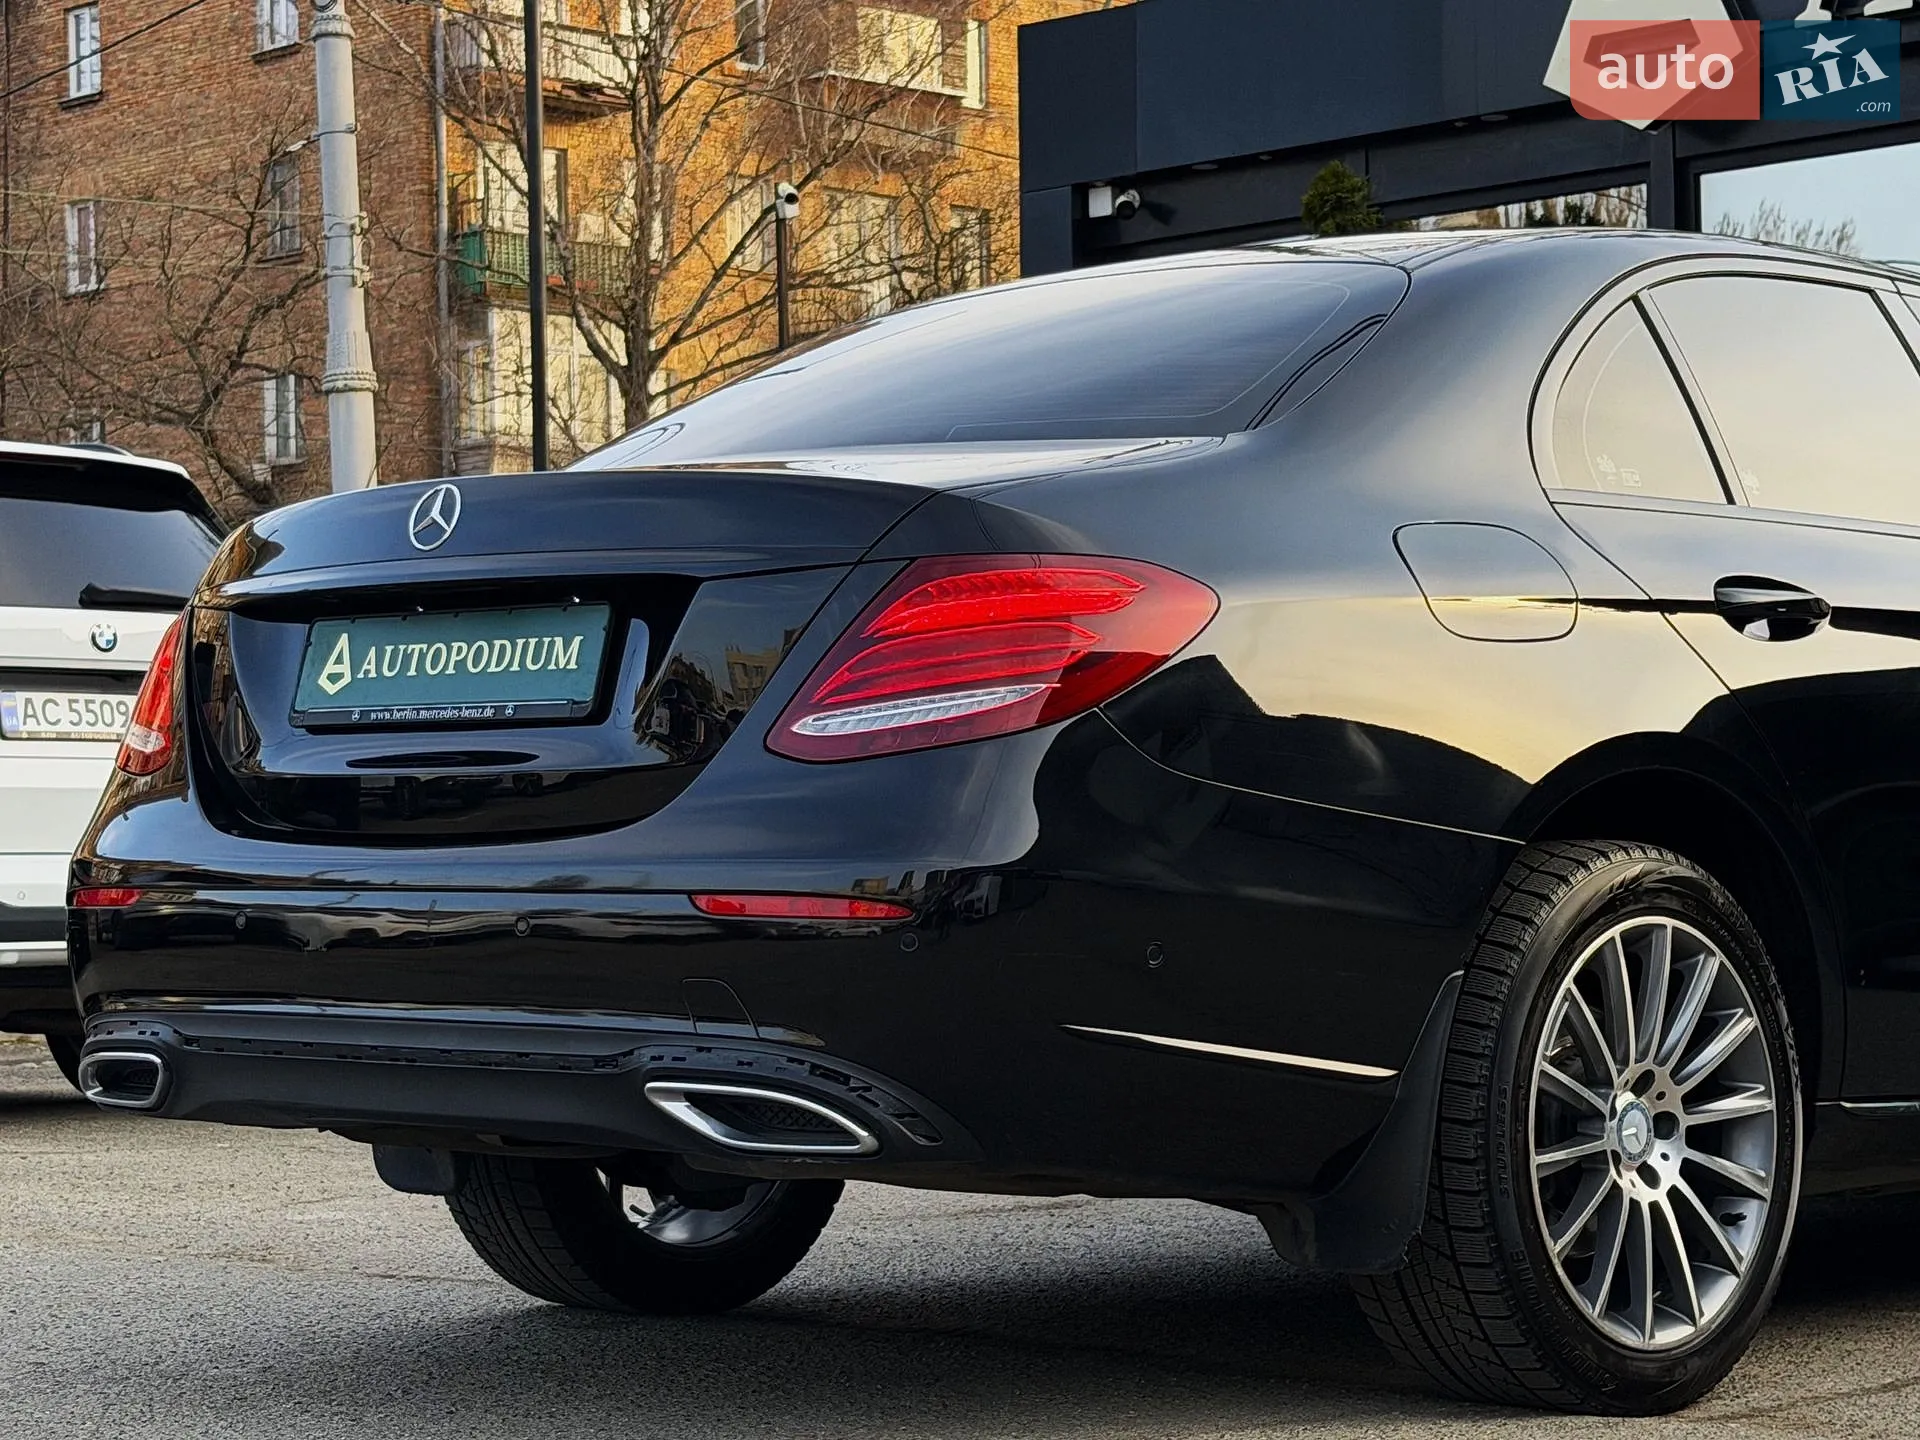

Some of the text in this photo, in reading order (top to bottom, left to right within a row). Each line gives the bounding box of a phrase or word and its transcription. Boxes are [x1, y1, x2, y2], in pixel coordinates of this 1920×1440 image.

[357, 635, 584, 679] AUTOPODIUM
[6, 717, 18, 727] UA
[22, 697, 130, 729] AC 5509
[370, 705, 496, 721] www.berlin.mercedes-benz.de
